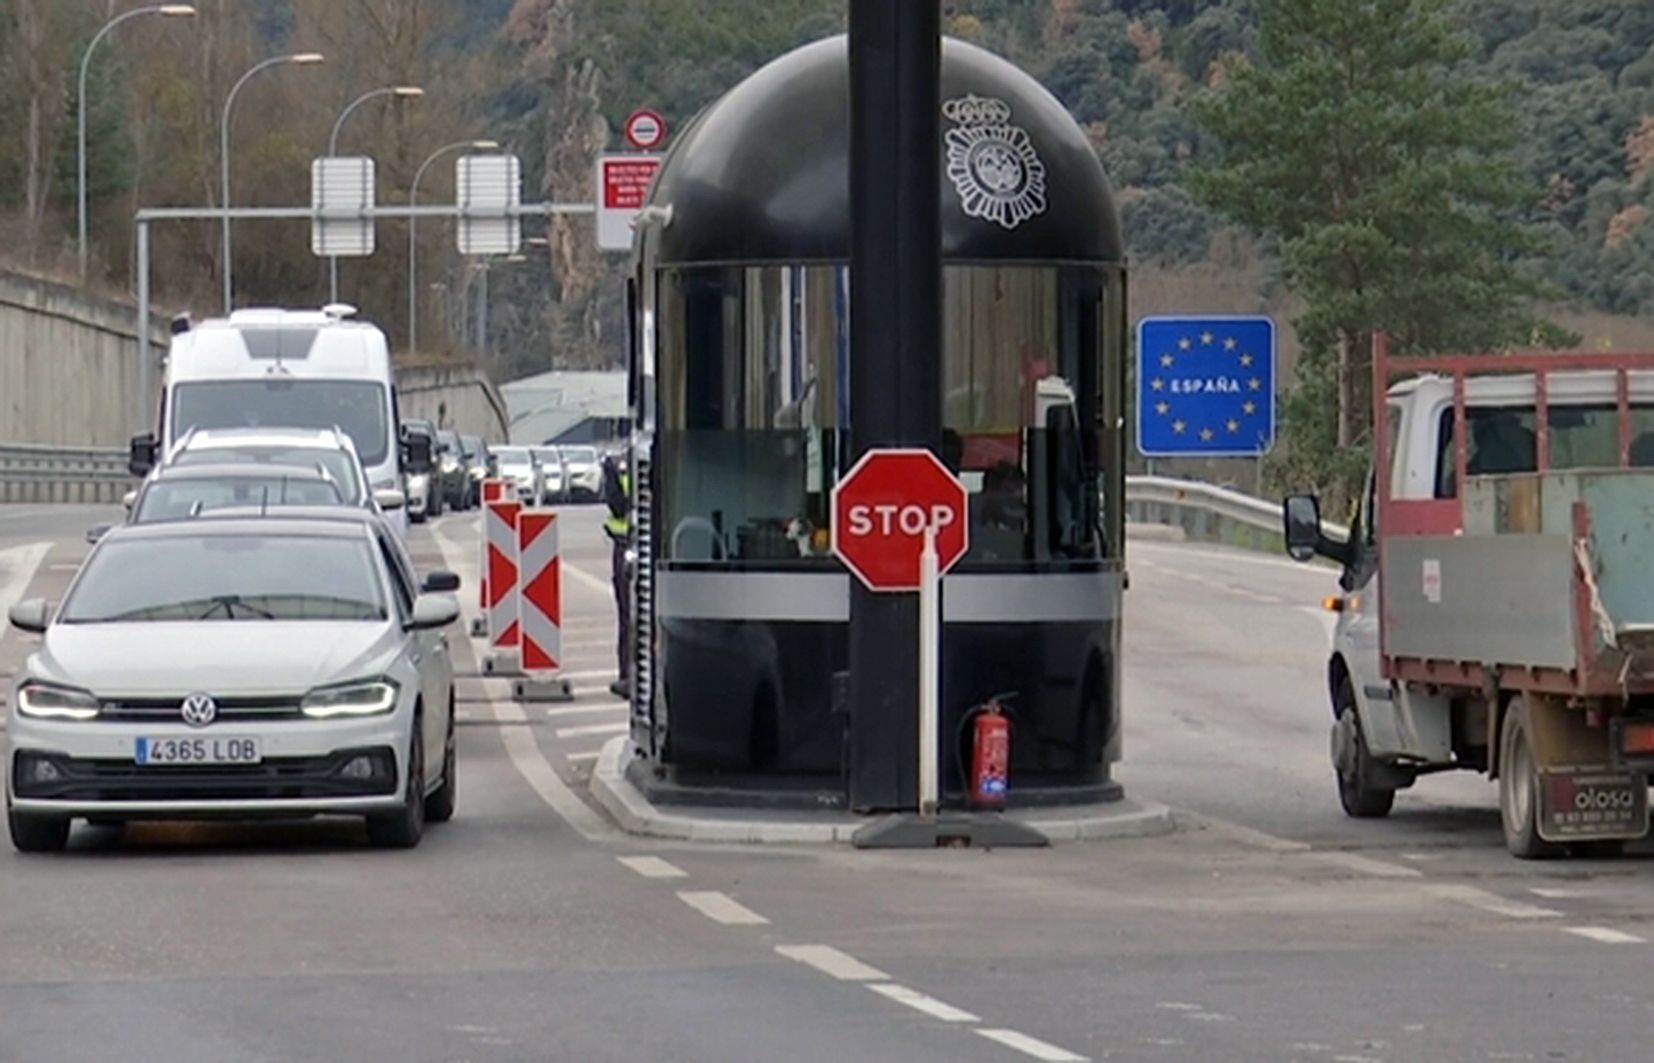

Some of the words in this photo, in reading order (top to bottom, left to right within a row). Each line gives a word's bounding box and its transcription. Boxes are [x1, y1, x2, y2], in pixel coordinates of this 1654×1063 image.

[1170, 376, 1241, 393] ESPAÑA
[848, 505, 955, 536] STOP
[151, 739, 206, 760] 4365
